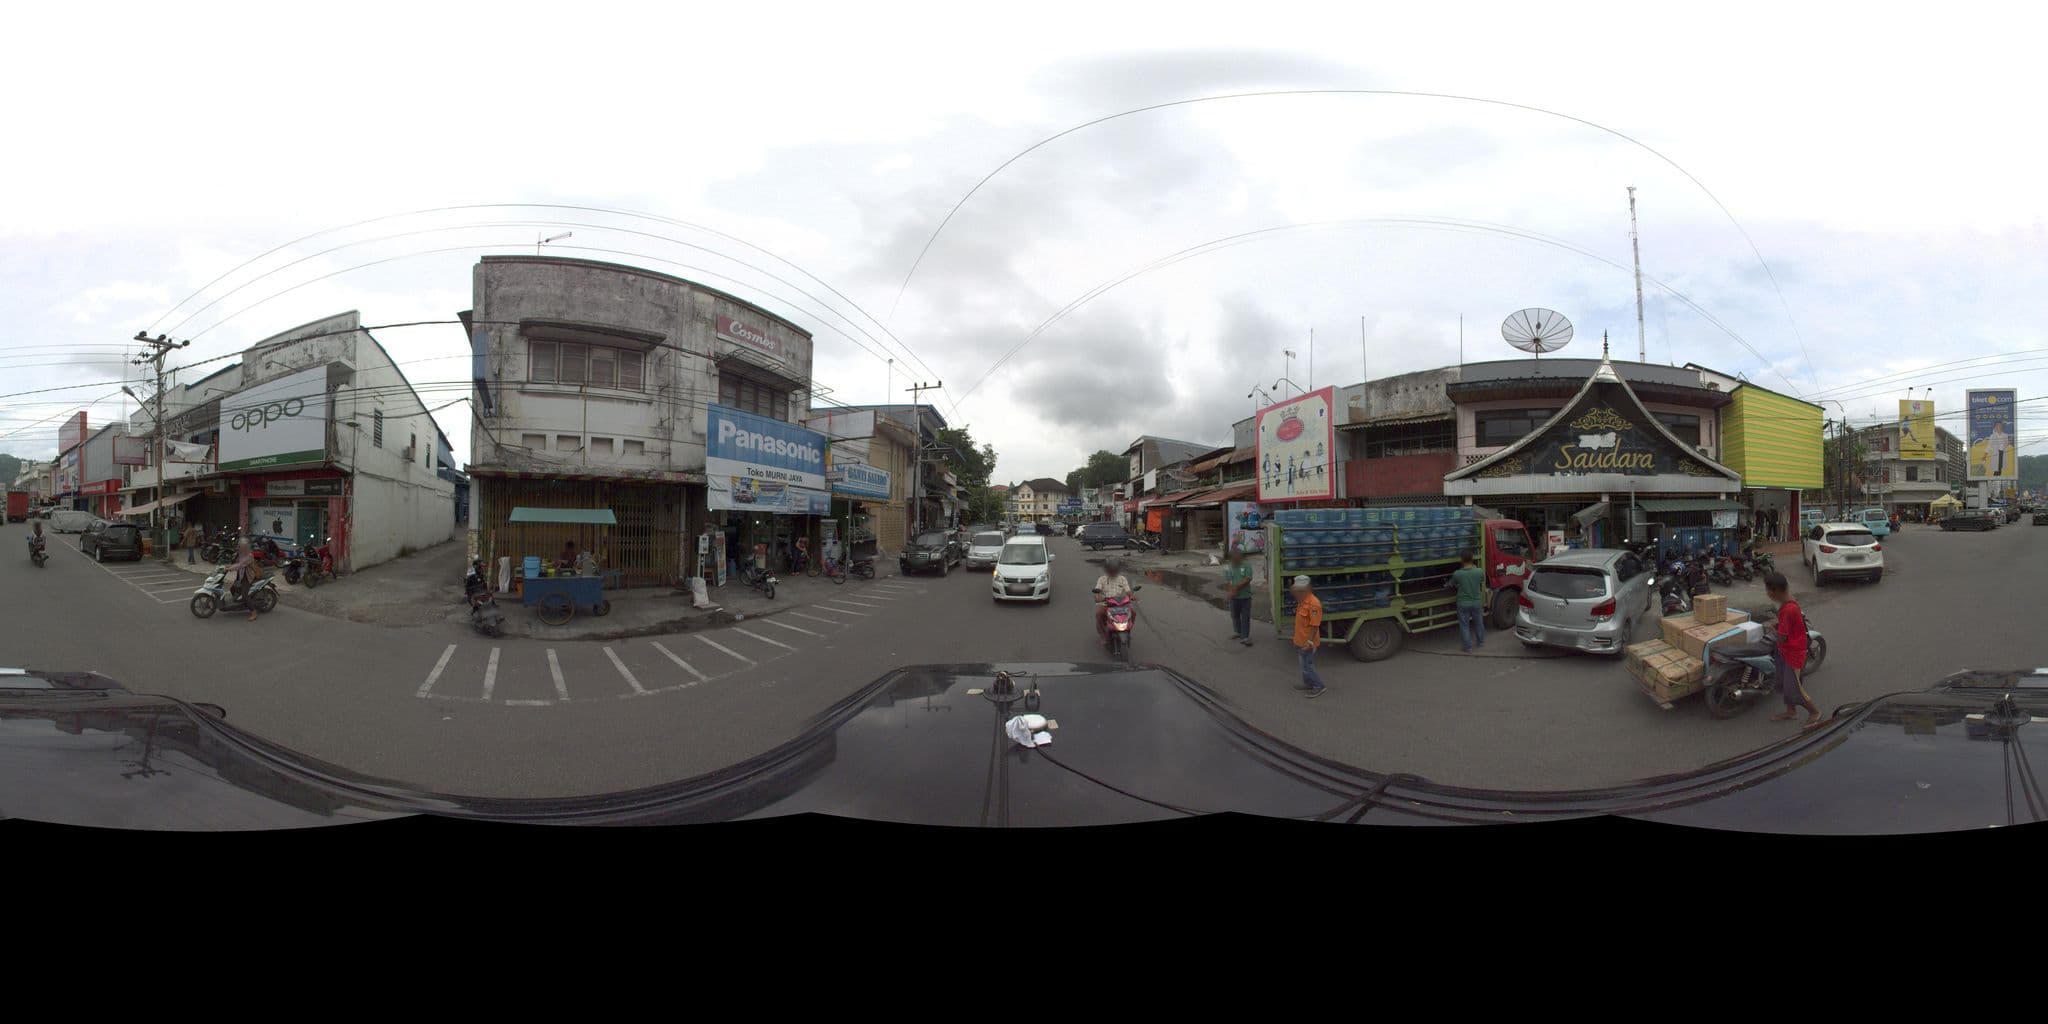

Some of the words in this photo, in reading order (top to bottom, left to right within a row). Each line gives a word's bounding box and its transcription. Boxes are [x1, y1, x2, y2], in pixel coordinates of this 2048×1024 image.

[729, 321, 776, 350] Cosmos
[718, 418, 821, 464] Panasonic
[1554, 436, 1656, 470] Saudara
[747, 467, 764, 478] Toko
[766, 470, 787, 481] MURNI
[789, 474, 803, 483] JAYA
